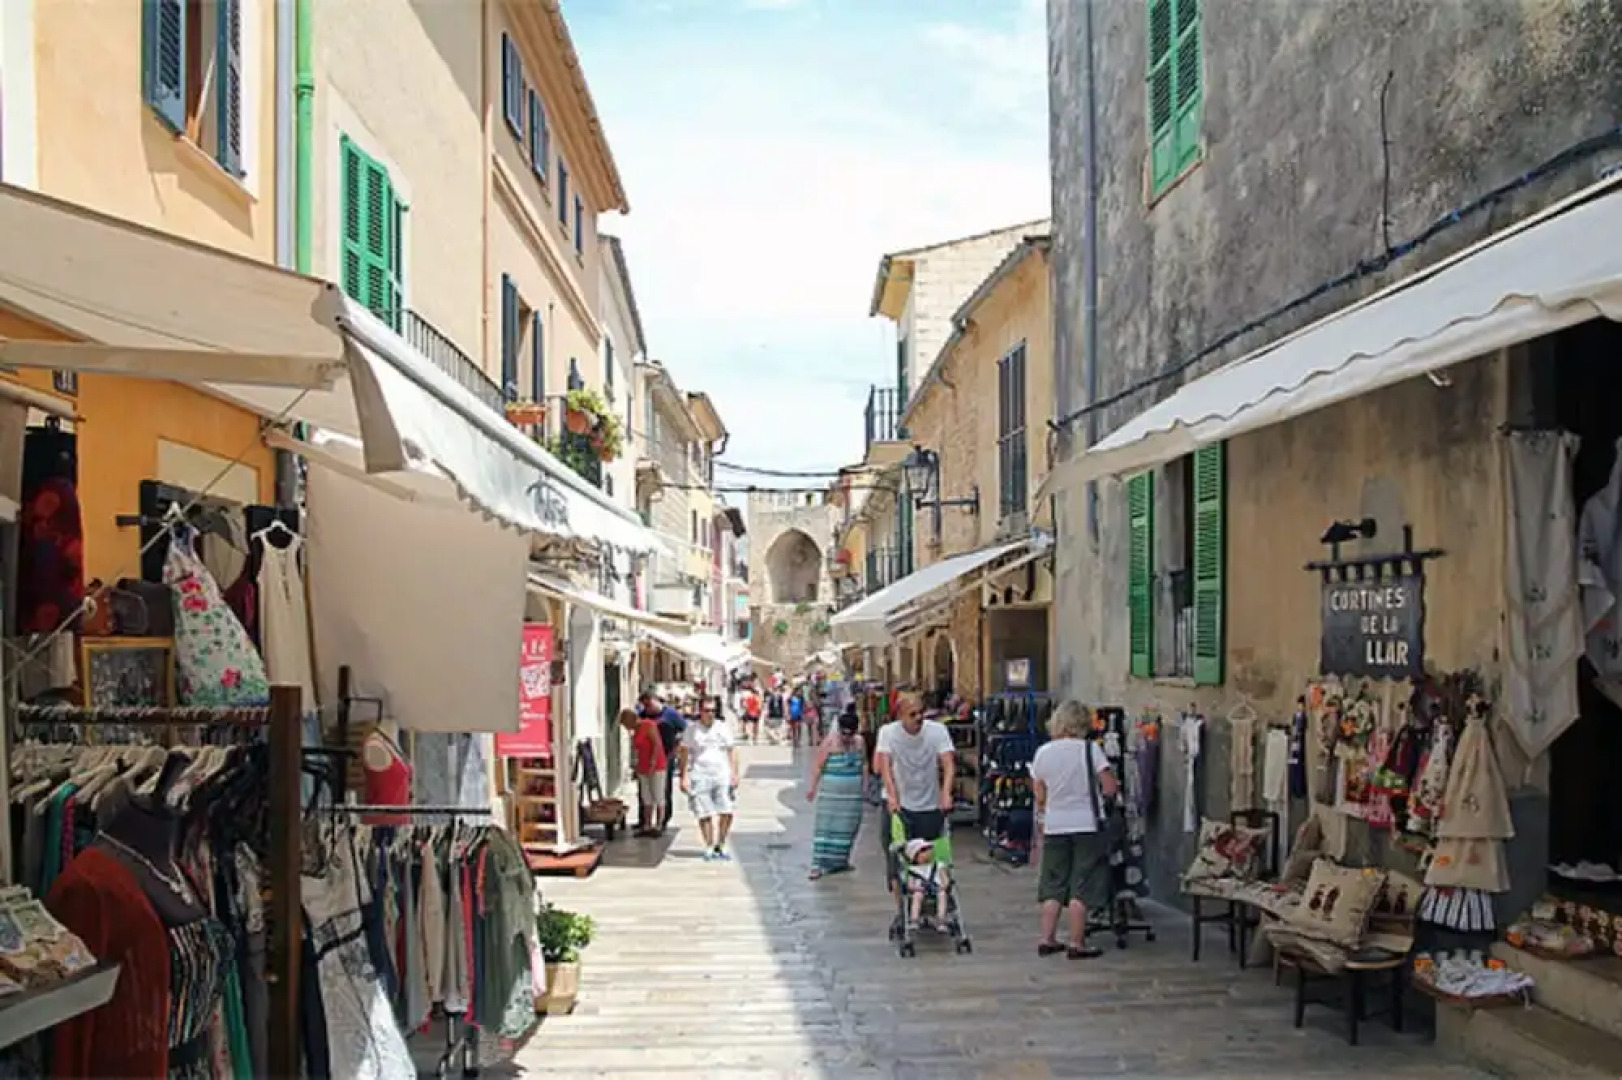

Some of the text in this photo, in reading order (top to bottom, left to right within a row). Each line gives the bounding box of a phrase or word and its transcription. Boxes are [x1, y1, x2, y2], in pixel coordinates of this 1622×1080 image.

[1330, 587, 1405, 611] CORTINES
[1361, 615, 1399, 634] DE LA
[1366, 640, 1409, 666] LLAR
